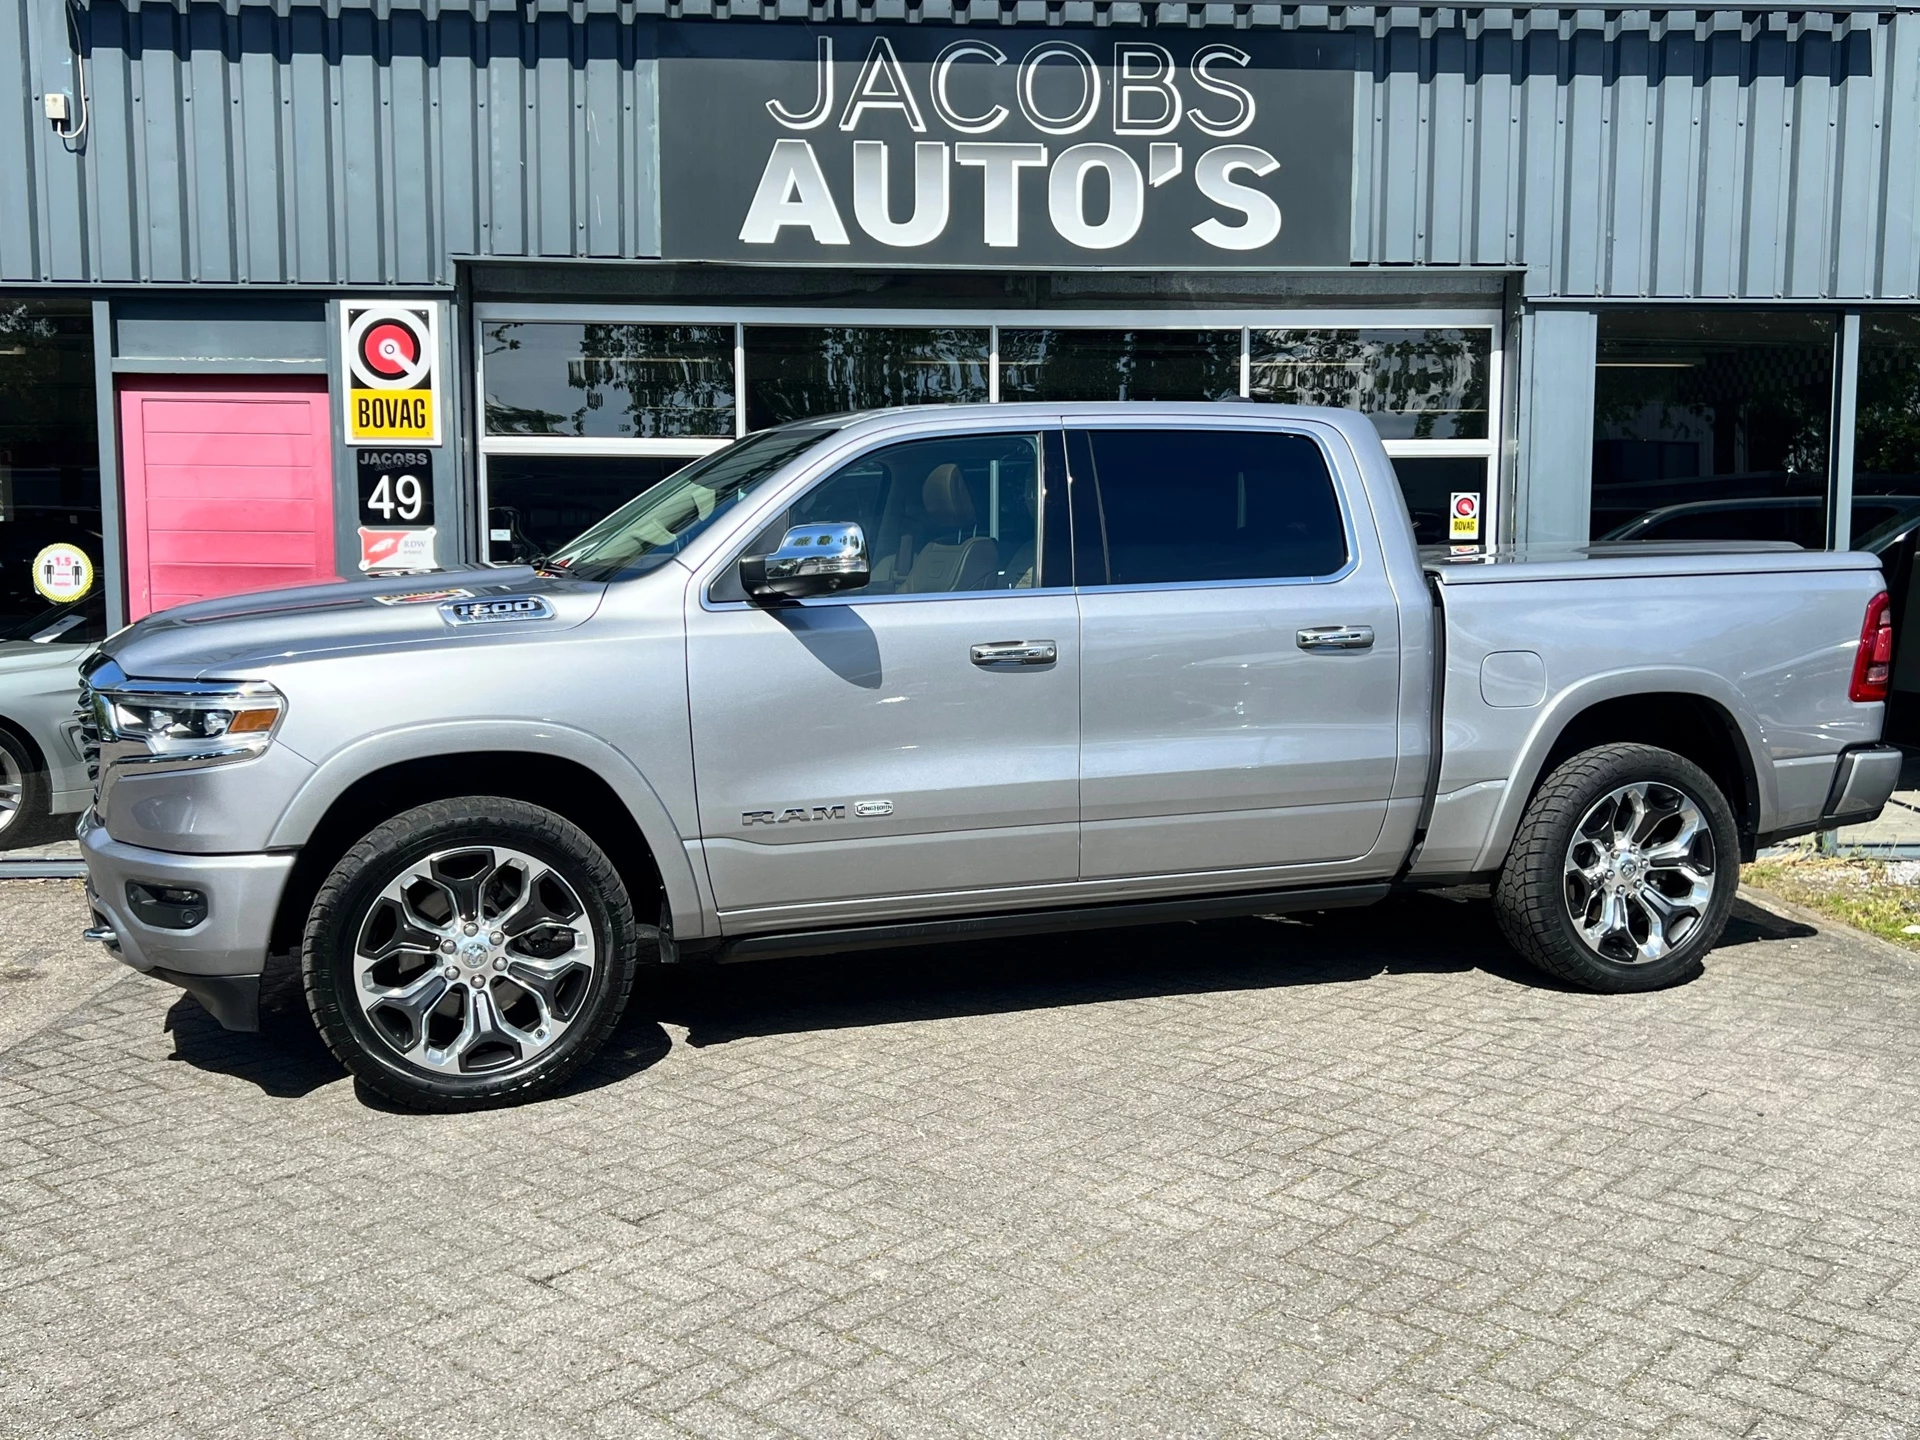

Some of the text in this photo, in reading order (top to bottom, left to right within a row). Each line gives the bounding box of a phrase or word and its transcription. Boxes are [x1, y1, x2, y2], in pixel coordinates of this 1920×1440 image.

[765, 35, 1256, 137] JACOBS
[738, 138, 1282, 250] AUTO'S
[358, 397, 426, 429] BOVAG
[360, 452, 428, 465] JACOBS
[367, 474, 422, 520] 49
[1454, 520, 1475, 531] BOVAG
[403, 540, 426, 548] RDW
[55, 556, 71, 566] 1.5
[459, 601, 535, 615] 1500
[742, 804, 846, 826] RAM
